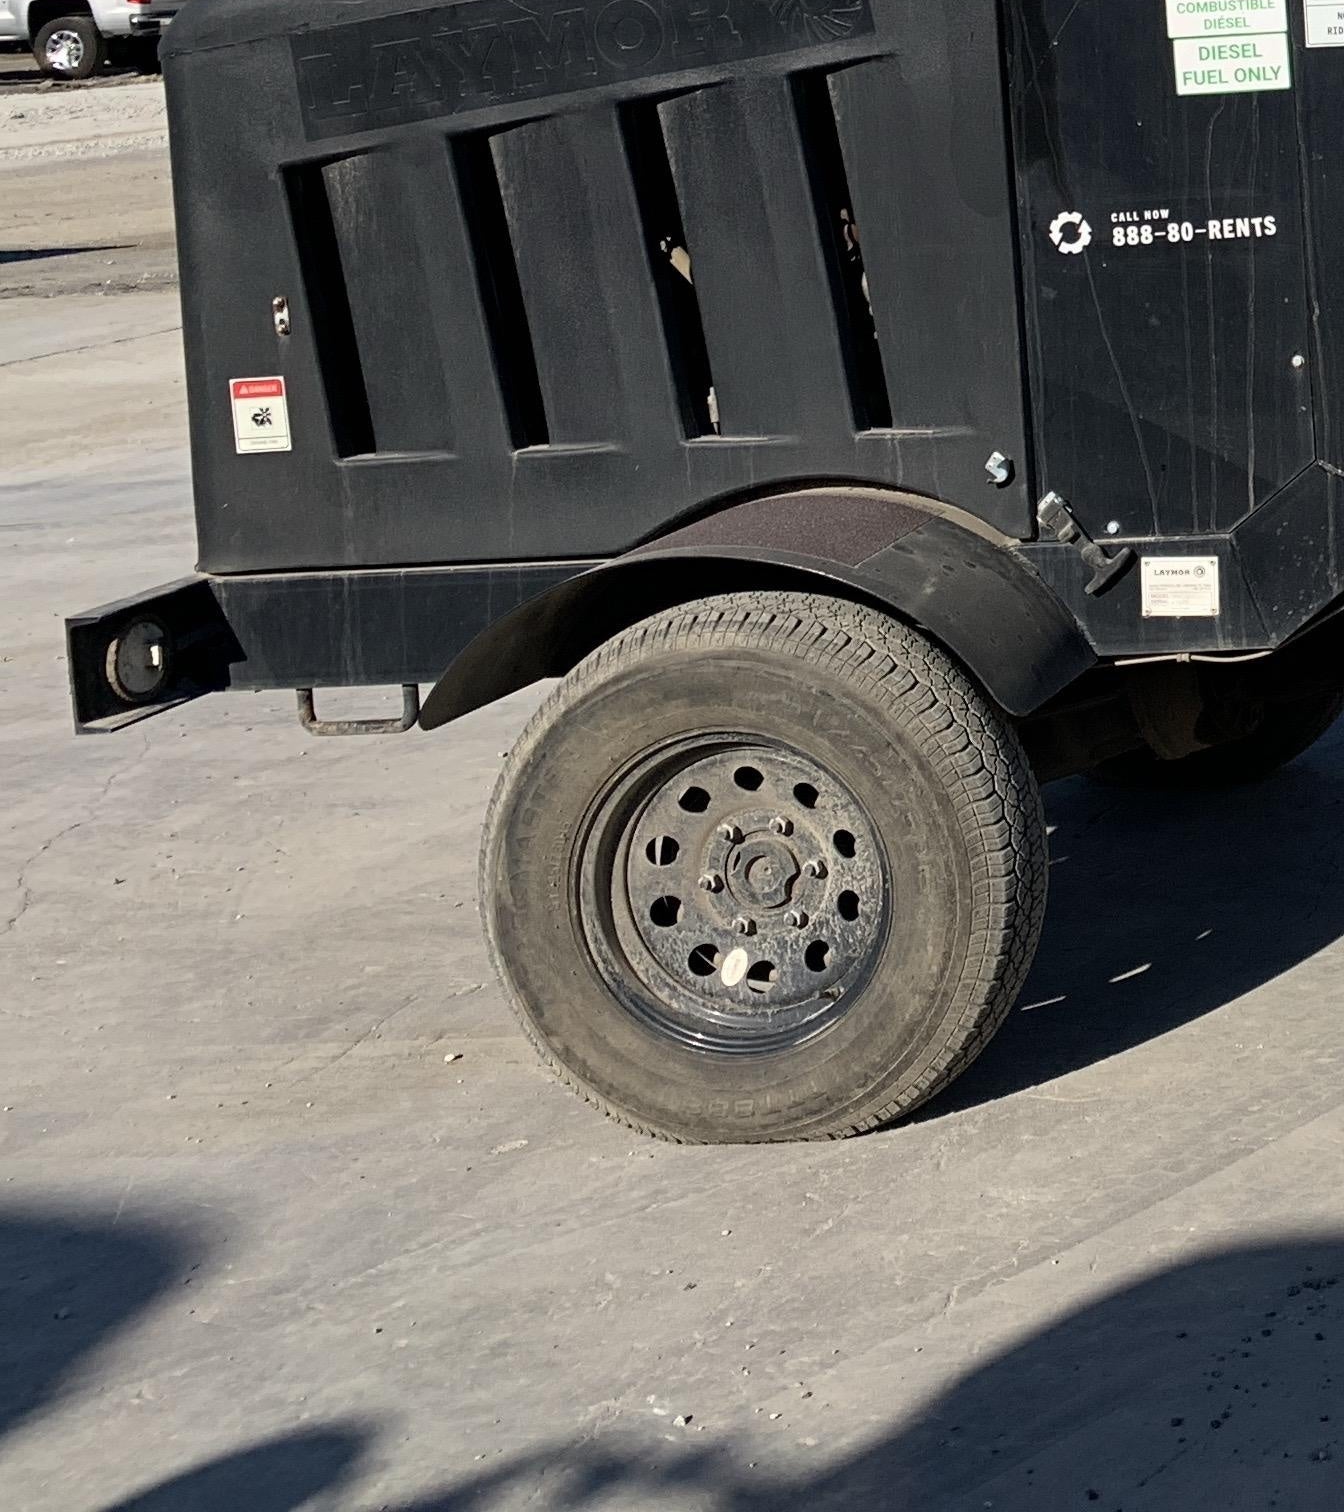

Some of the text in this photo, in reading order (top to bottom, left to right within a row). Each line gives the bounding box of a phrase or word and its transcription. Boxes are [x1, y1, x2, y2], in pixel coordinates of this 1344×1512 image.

[1198, 43, 1263, 61] DIESEL
[1182, 65, 1282, 86] FUEL ONLY
[1110, 209, 1170, 223] CALL NOW
[1112, 215, 1278, 247] 888-80-RENTS
